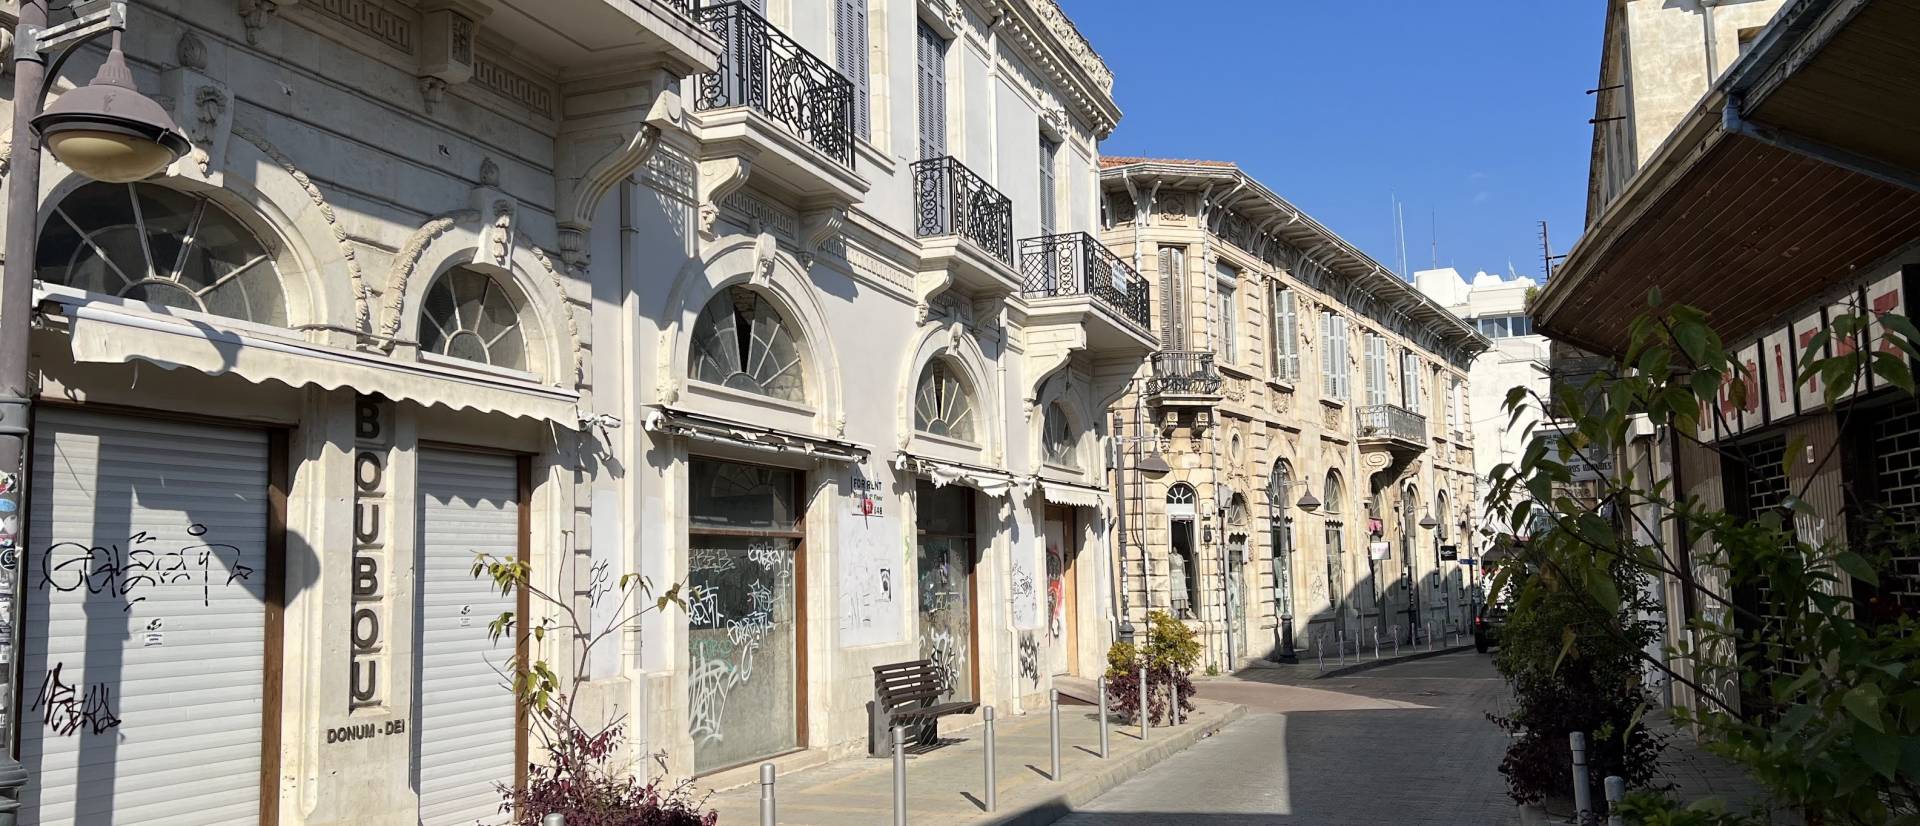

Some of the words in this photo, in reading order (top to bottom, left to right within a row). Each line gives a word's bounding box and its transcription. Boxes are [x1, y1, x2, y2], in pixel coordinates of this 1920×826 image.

[853, 478, 865, 489] FOR
[866, 480, 882, 491] RENT
[352, 403, 381, 701] BOUBOU
[327, 723, 375, 744] DONUM
[385, 719, 405, 735] DEI
